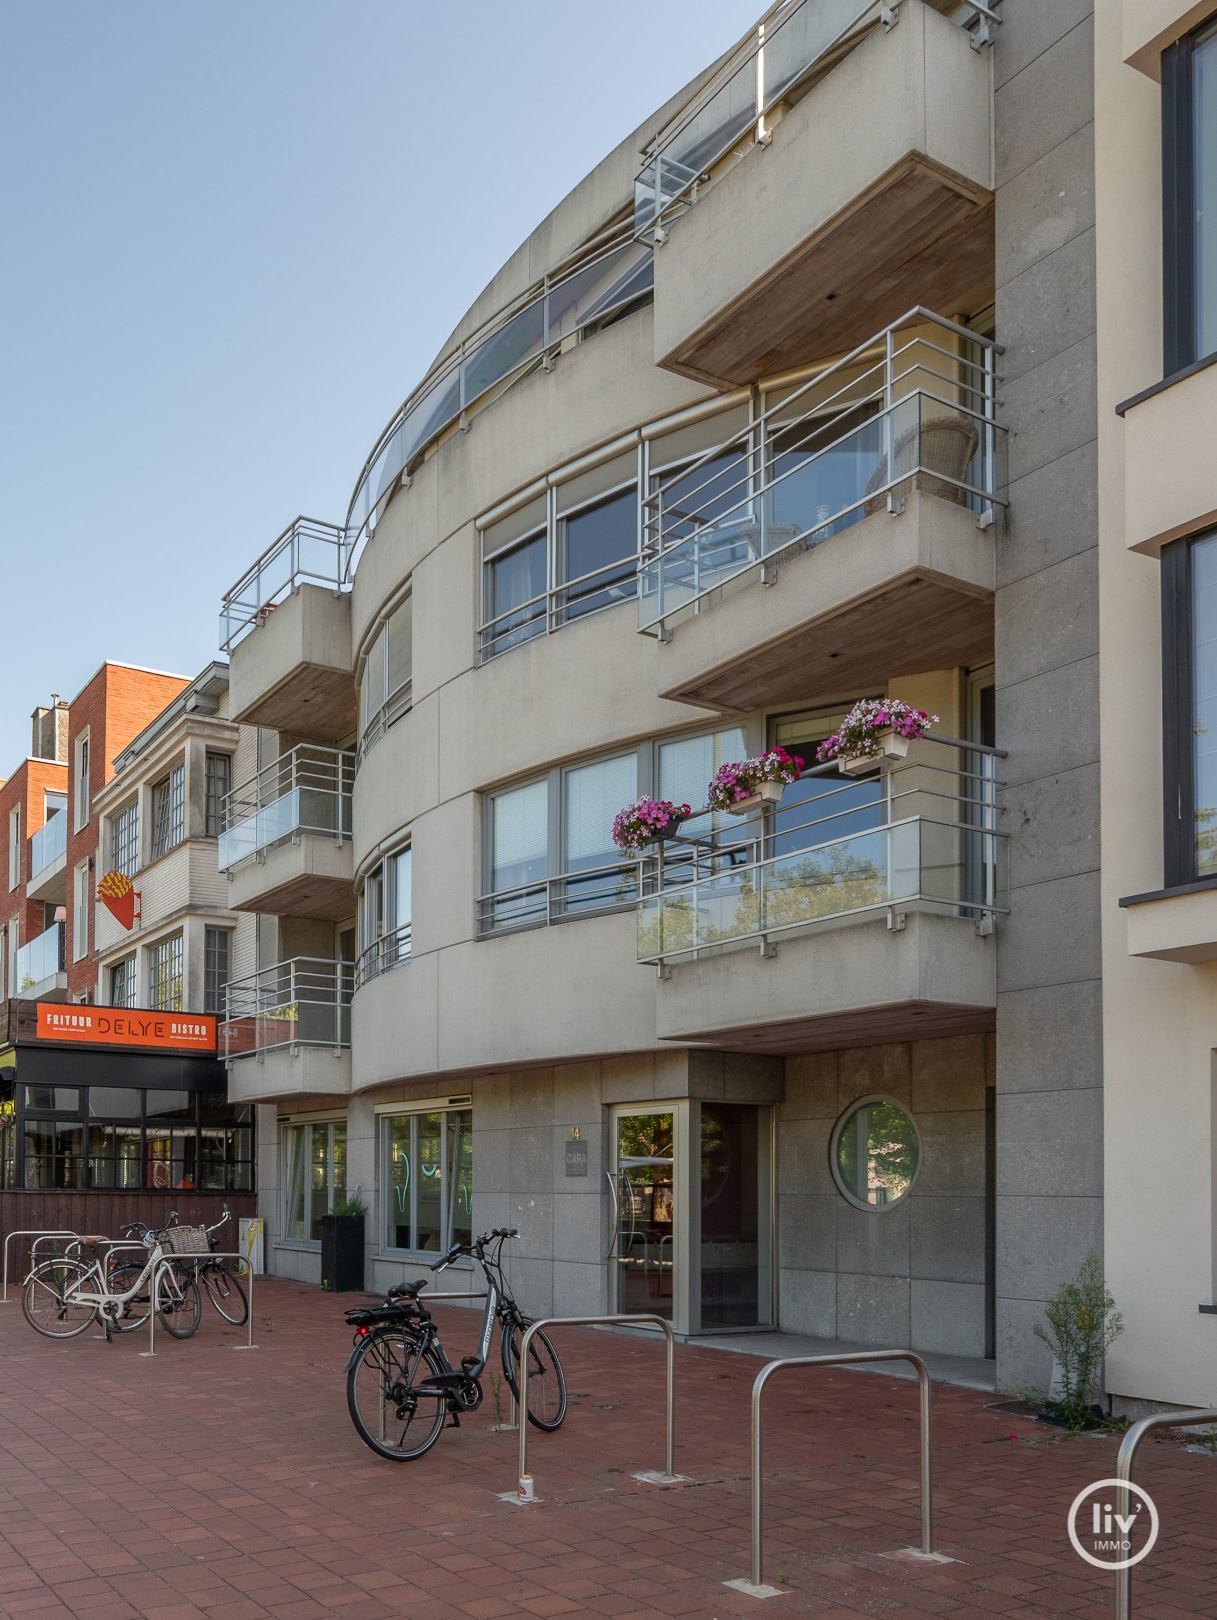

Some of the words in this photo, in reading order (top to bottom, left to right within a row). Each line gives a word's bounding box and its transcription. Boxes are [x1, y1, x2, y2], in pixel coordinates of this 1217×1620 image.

[46, 1013, 92, 1028] FRITUUR
[98, 1017, 165, 1038] DELYE
[171, 1023, 207, 1036] BISTRO
[571, 1126, 580, 1140] 14
[566, 1153, 587, 1165] CARA
